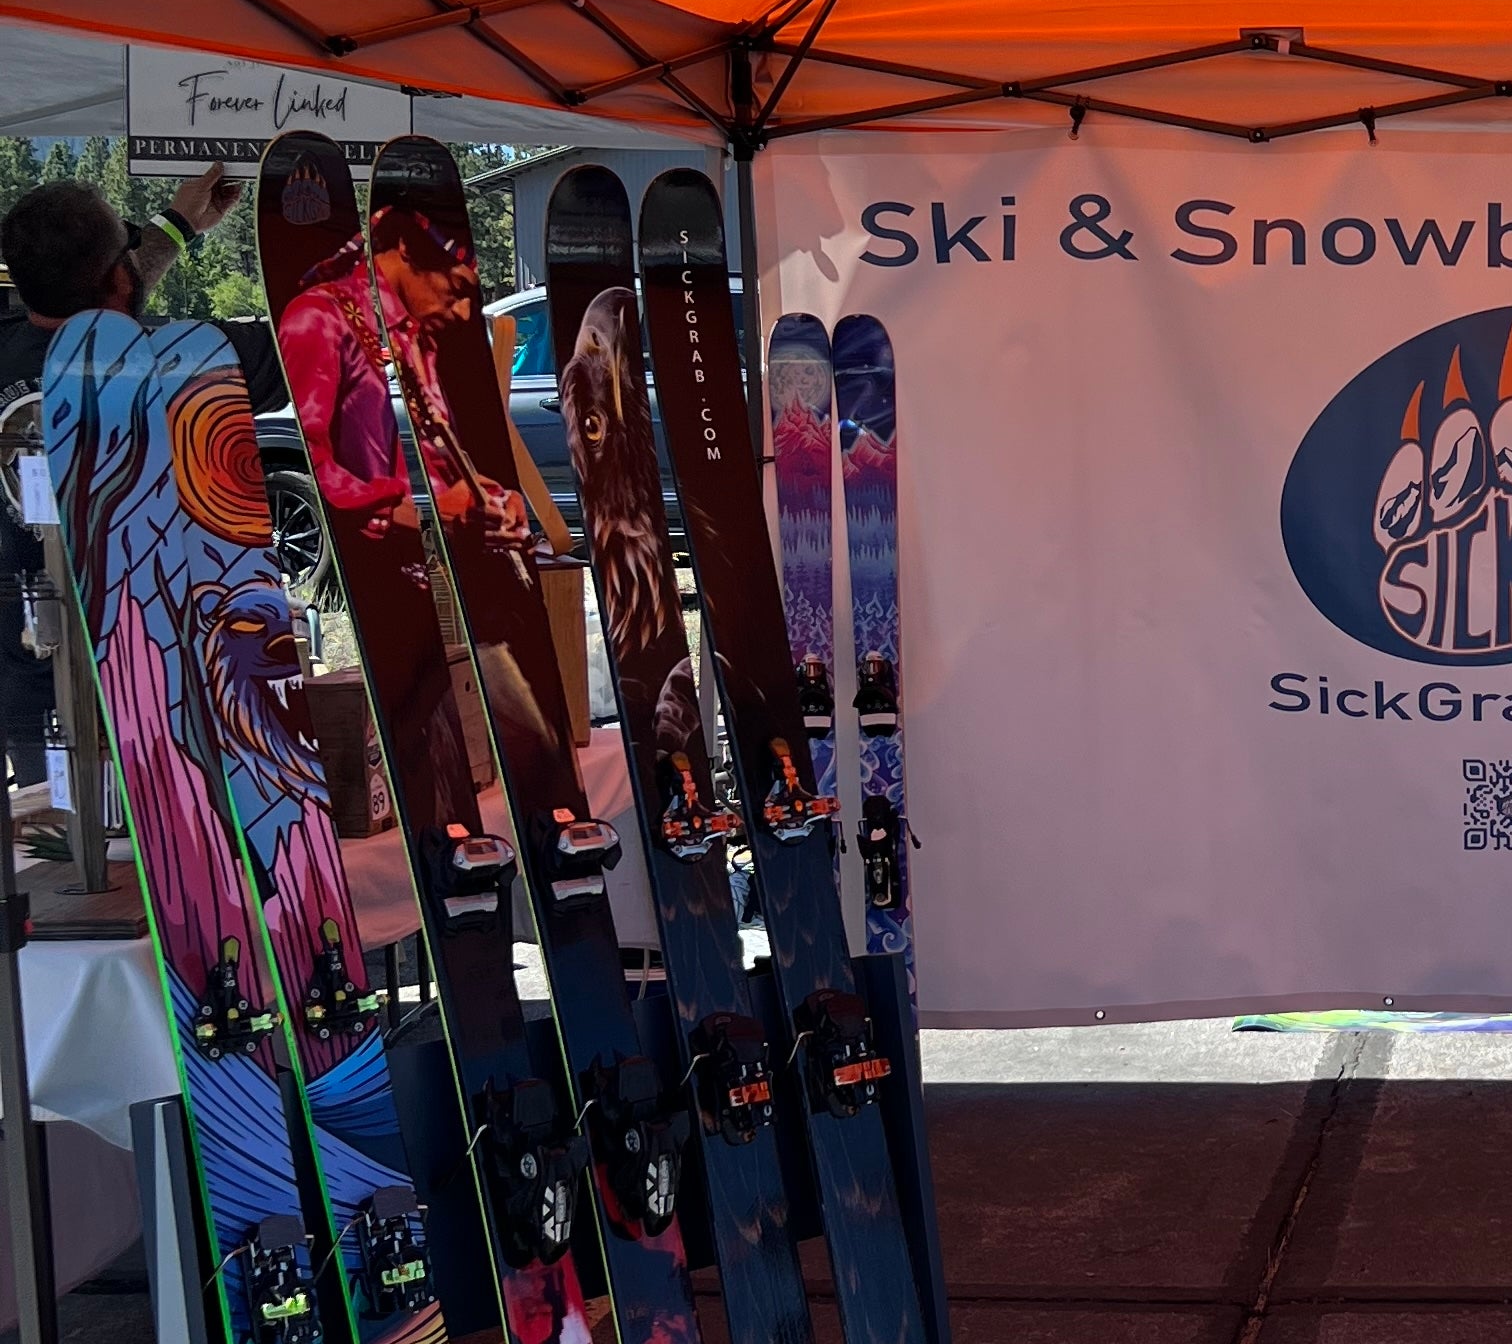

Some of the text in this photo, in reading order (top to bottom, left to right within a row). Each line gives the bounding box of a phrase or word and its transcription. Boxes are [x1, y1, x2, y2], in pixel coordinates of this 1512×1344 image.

[178, 70, 347, 129] Forever Linked
[135, 139, 266, 157] PERMANEN
[859, 195, 1017, 268] Ski
[1060, 193, 1138, 262] &
